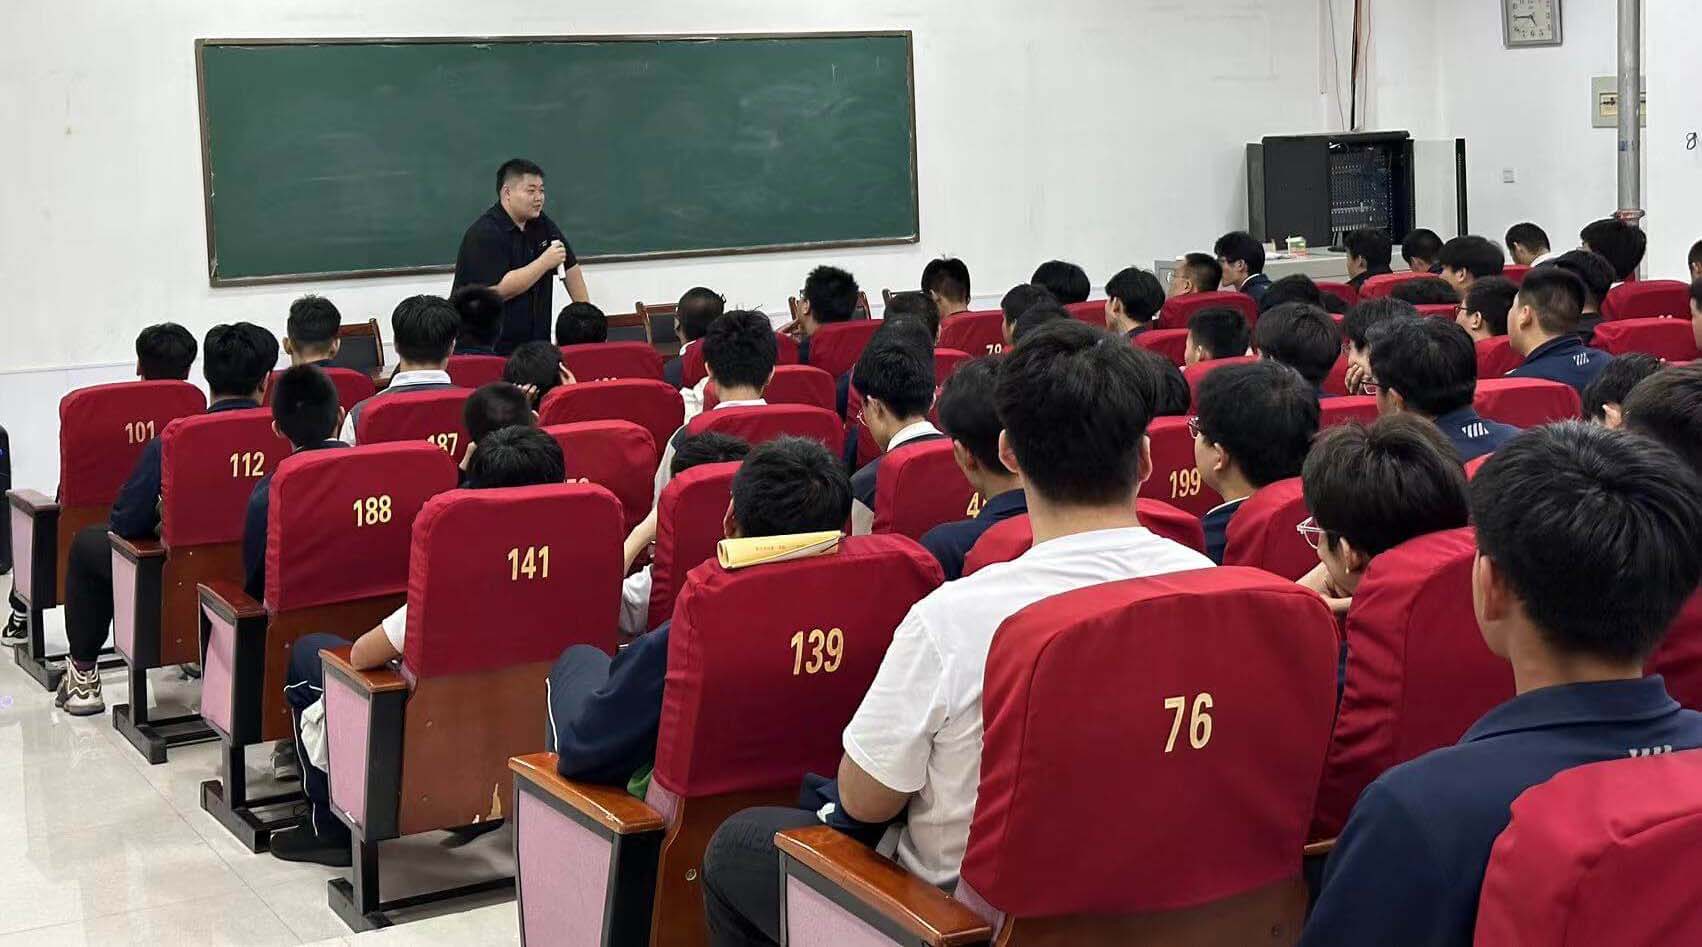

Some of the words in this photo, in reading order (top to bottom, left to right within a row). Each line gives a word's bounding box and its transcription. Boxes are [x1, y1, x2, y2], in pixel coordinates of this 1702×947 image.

[1685, 131, 1698, 150] 8
[125, 420, 155, 443] 101
[229, 451, 265, 478] 112
[1169, 467, 1201, 499] 199
[353, 494, 392, 527] 188
[508, 545, 550, 581] 141
[790, 627, 844, 675] 139
[1163, 692, 1214, 753] 76
